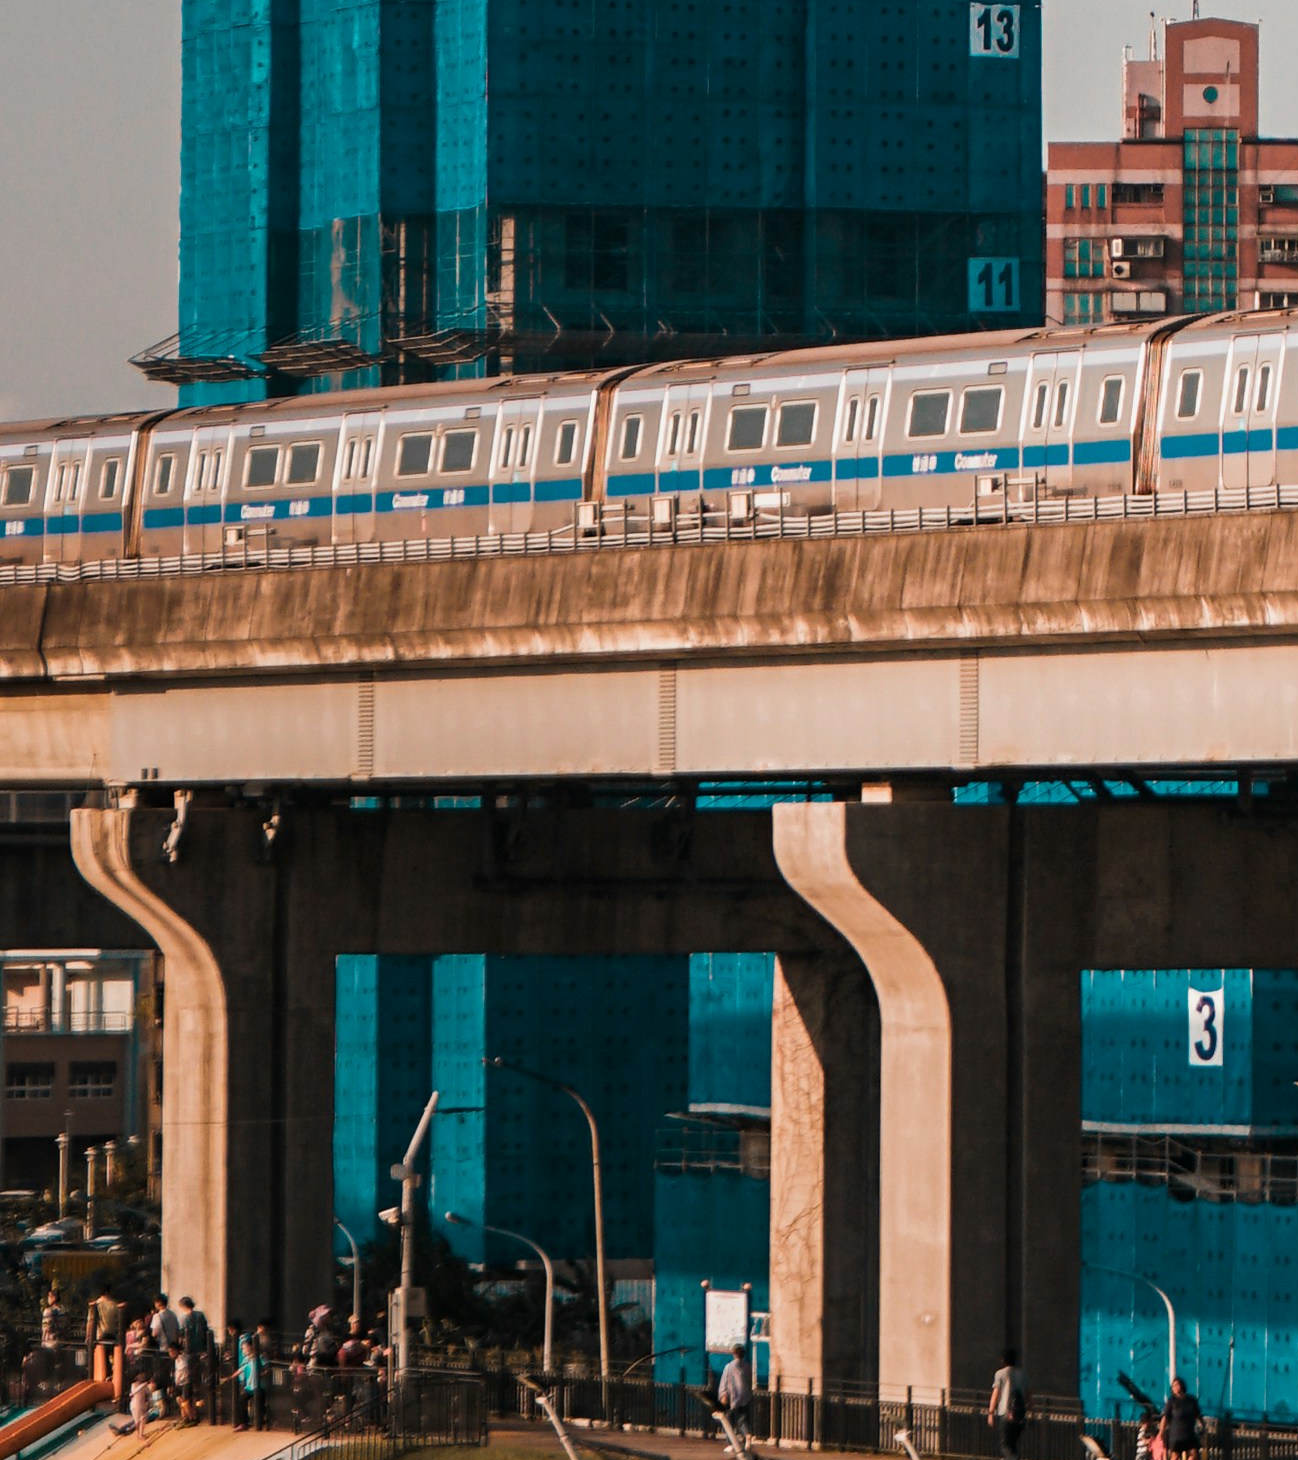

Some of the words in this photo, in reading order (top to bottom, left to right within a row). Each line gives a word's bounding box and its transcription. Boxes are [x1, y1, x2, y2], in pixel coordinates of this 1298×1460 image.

[977, 8, 1015, 52] 13
[977, 263, 1014, 307] 11
[1194, 994, 1218, 1062] 3
